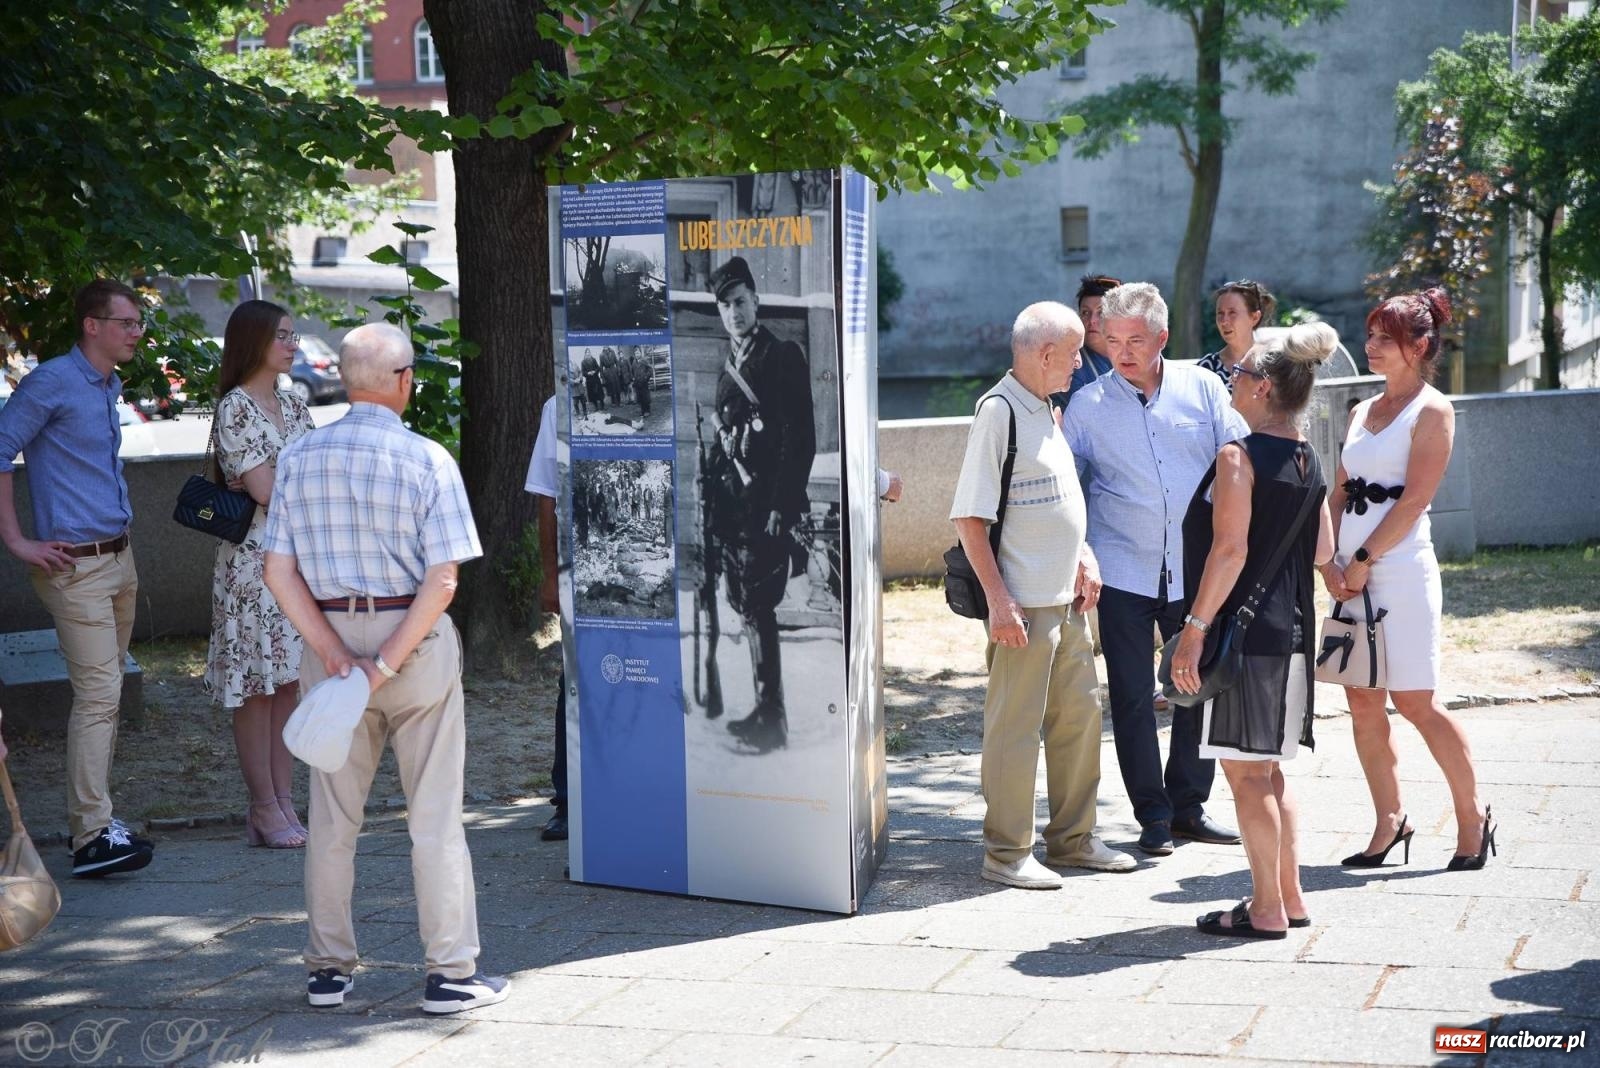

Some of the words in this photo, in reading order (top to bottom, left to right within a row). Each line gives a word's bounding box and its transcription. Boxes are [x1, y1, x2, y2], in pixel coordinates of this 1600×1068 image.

[679, 215, 813, 251] LUBELSZCZYZNA
[625, 659, 649, 667] INSTYTUT
[625, 667, 646, 677] PAMIĘCI
[626, 675, 660, 684] NARODOWEJ
